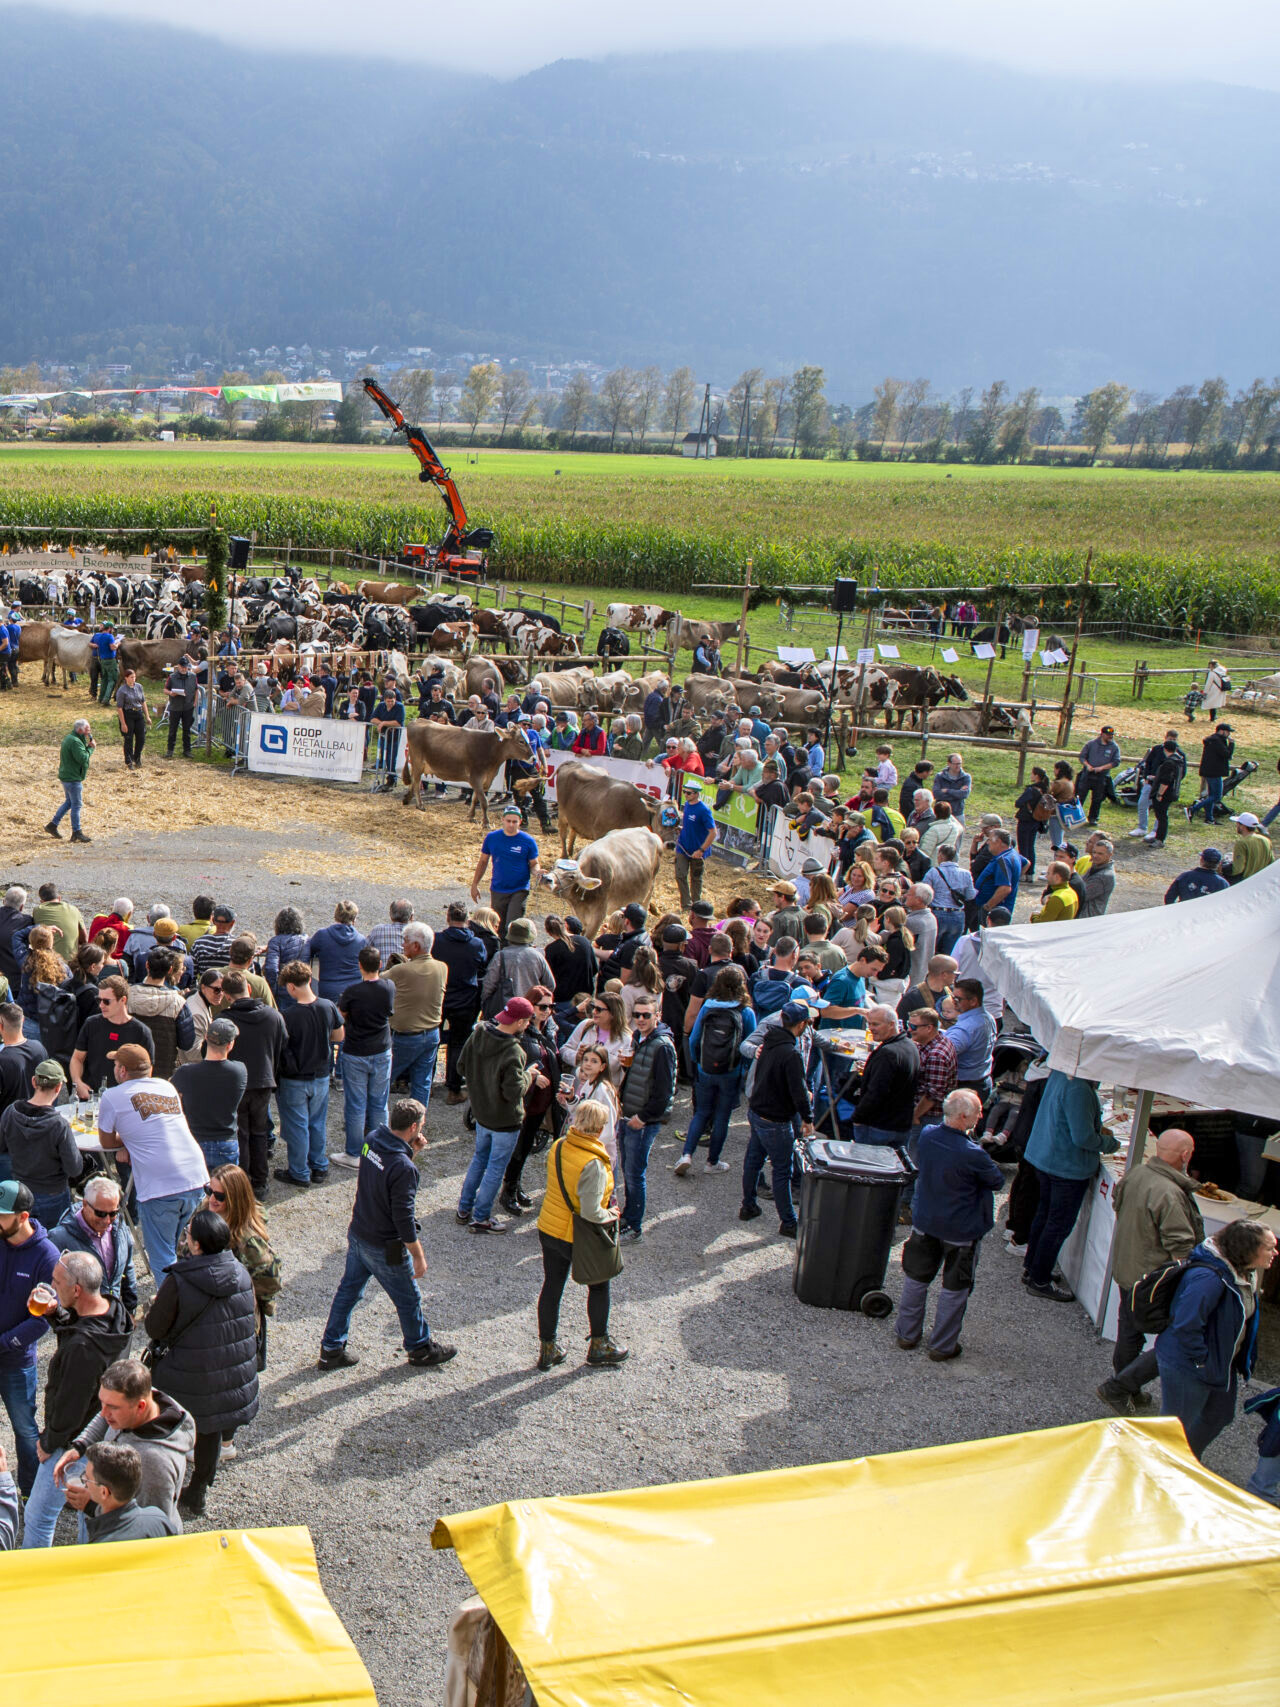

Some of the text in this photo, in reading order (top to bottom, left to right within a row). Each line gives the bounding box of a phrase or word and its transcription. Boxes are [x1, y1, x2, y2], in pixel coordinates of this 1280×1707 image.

[293, 727, 322, 738] GOOP
[293, 737, 354, 752] METALLBAU
[292, 747, 336, 760] TECHNIK
